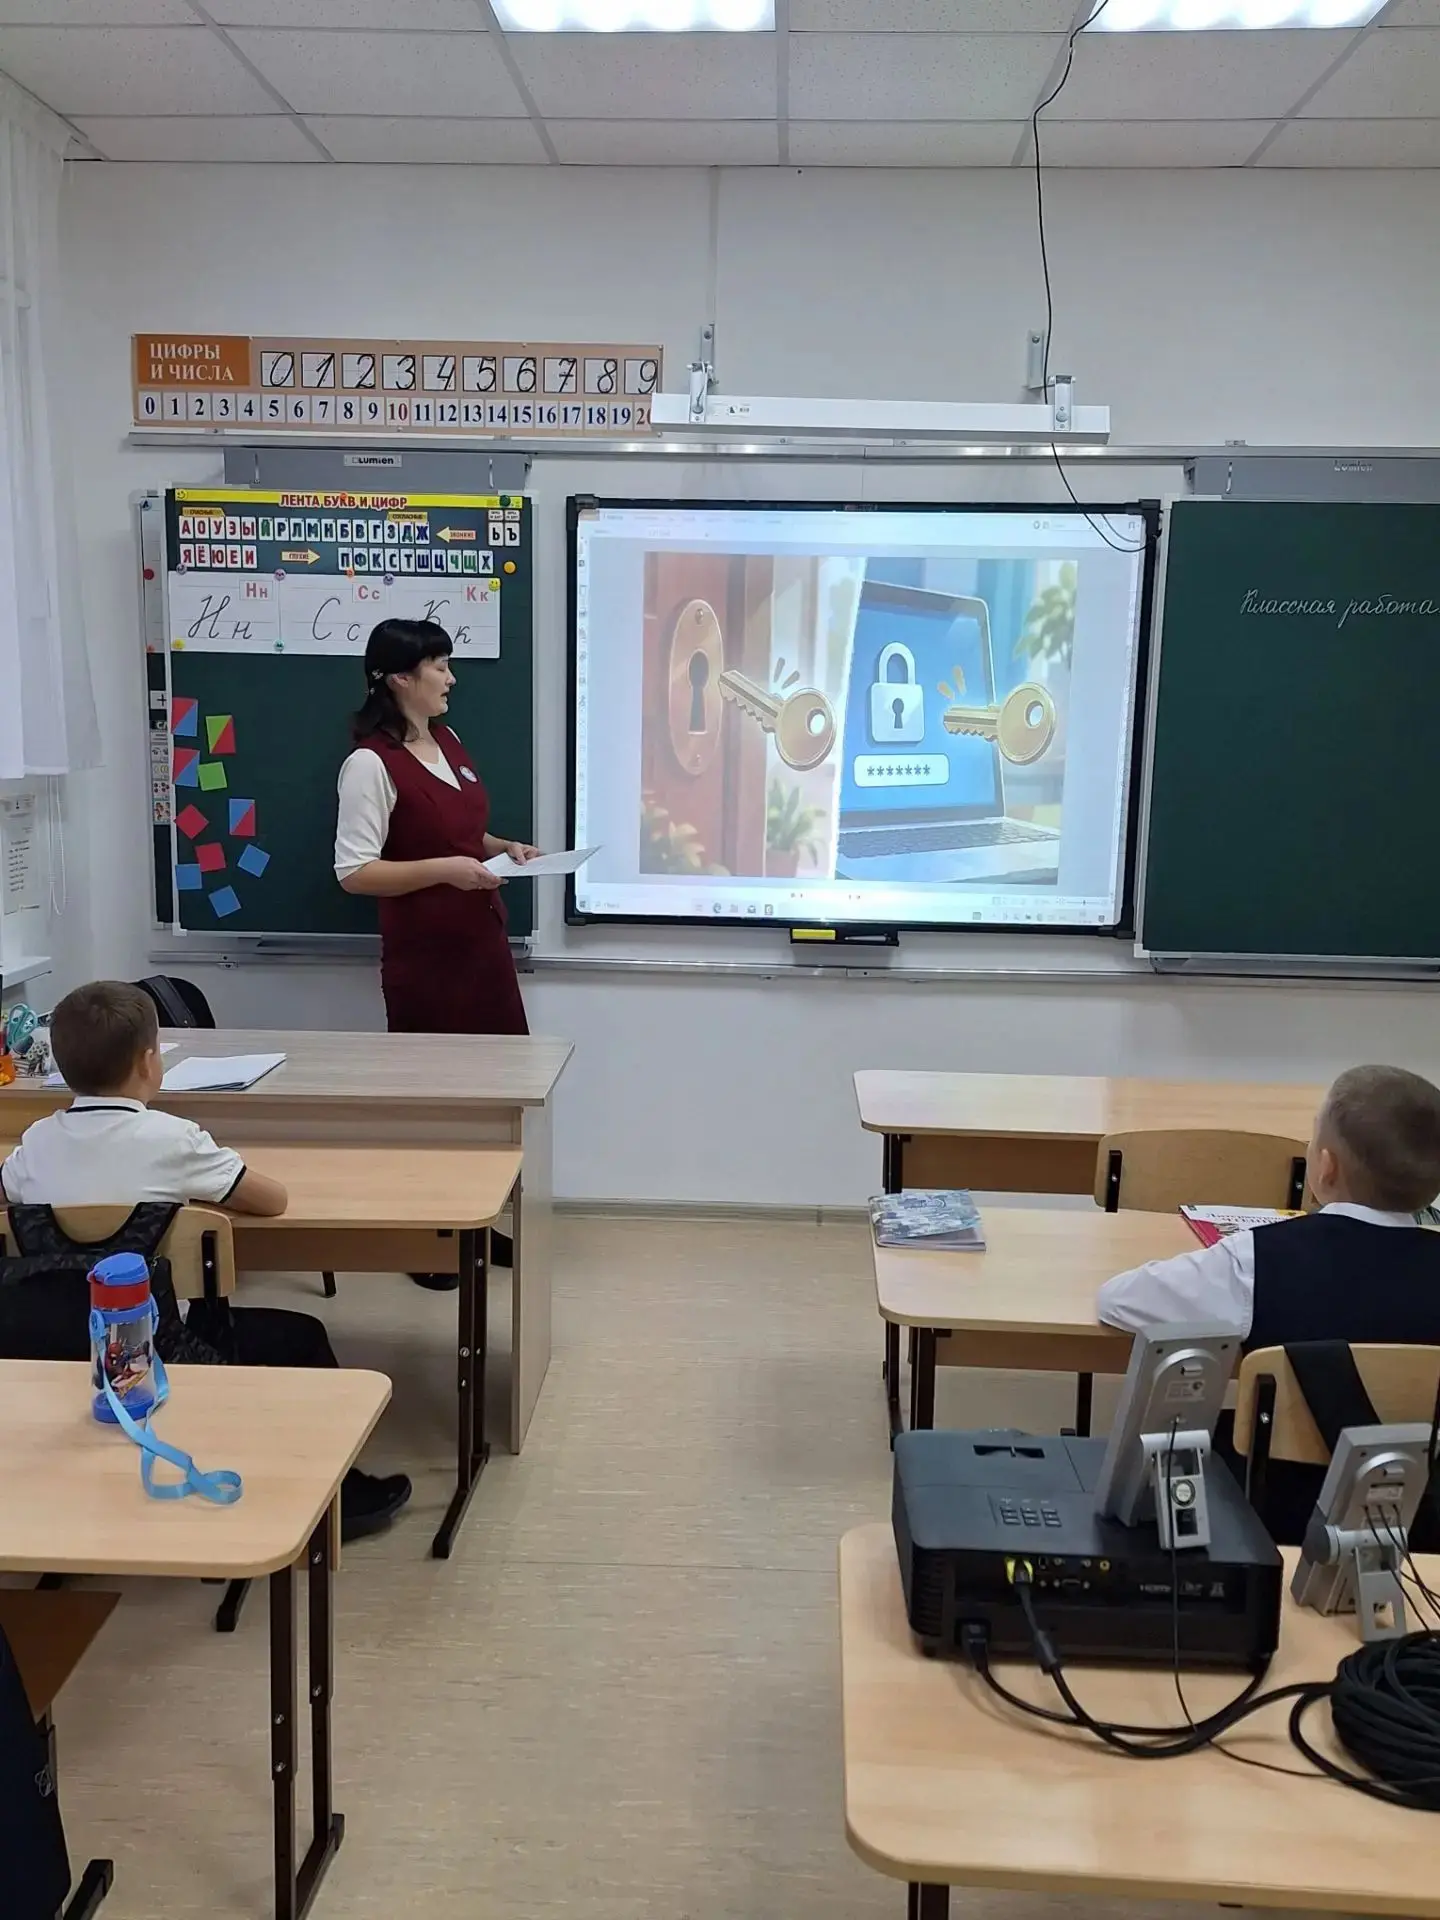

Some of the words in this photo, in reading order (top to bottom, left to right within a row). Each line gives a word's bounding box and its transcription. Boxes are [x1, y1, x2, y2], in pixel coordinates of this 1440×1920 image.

[150, 343, 221, 360] ЦИФРЫ
[151, 364, 163, 380] И
[169, 364, 234, 382] ЧИСЛА
[270, 352, 294, 387] 0
[316, 353, 335, 388] 1
[355, 354, 375, 388] 2
[396, 355, 416, 390] 3
[437, 356, 456, 391] 4
[477, 357, 497, 392] 5
[517, 358, 537, 392] 6
[558, 358, 577, 393] 7
[597, 359, 617, 394] 8
[638, 360, 658, 394] 9
[145, 397, 155, 414] 0
[172, 398, 178, 415] 1
[195, 398, 204, 415] 2
[220, 398, 229, 416] 3
[244, 400, 254, 416] 4
[269, 400, 279, 417] 5
[294, 401, 303, 418] 6
[319, 401, 328, 418] 7
[344, 402, 353, 419] 8
[368, 402, 378, 419] 9
[389, 403, 408, 421] 10
[415, 404, 430, 421] 11
[439, 404, 457, 422] 12
[464, 405, 482, 422] 13
[489, 405, 507, 423] 14
[513, 406, 531, 423] 15
[538, 406, 556, 423] 16
[563, 407, 581, 424] 17
[588, 407, 606, 424] 18
[613, 408, 631, 424] 19
[281, 495, 320, 507] ЛЕНТА
[324, 496, 356, 507] БУКВ
[360, 497, 368, 508] И
[371, 497, 407, 510] ЦИФР
[182, 520, 191, 534] А
[197, 520, 206, 535] О
[213, 520, 222, 535] У
[229, 521, 236, 536] Э
[243, 521, 255, 536] Ы
[261, 519, 270, 537] Й
[277, 522, 286, 537] Р
[292, 522, 302, 537] Л
[307, 523, 318, 538] М
[324, 523, 333, 538] Н
[340, 523, 349, 538] Б
[356, 524, 365, 539] В
[373, 524, 381, 539] Г
[387, 524, 395, 539] З
[402, 525, 413, 542] Д
[416, 526, 429, 541] Ж
[183, 549, 192, 563] Я
[199, 546, 206, 564] Ё
[213, 550, 224, 564] Ю
[230, 550, 238, 564] Е
[246, 550, 254, 564] И
[340, 554, 350, 568] П
[355, 553, 367, 568] Ф
[372, 554, 382, 568] К
[389, 554, 397, 568] С
[404, 554, 413, 568] Т
[417, 554, 429, 569] Ш
[434, 554, 444, 573] Ц
[450, 555, 459, 569] Ч
[464, 555, 477, 572] Щ
[482, 555, 491, 570] Х
[1240, 588, 1336, 614] Классная
